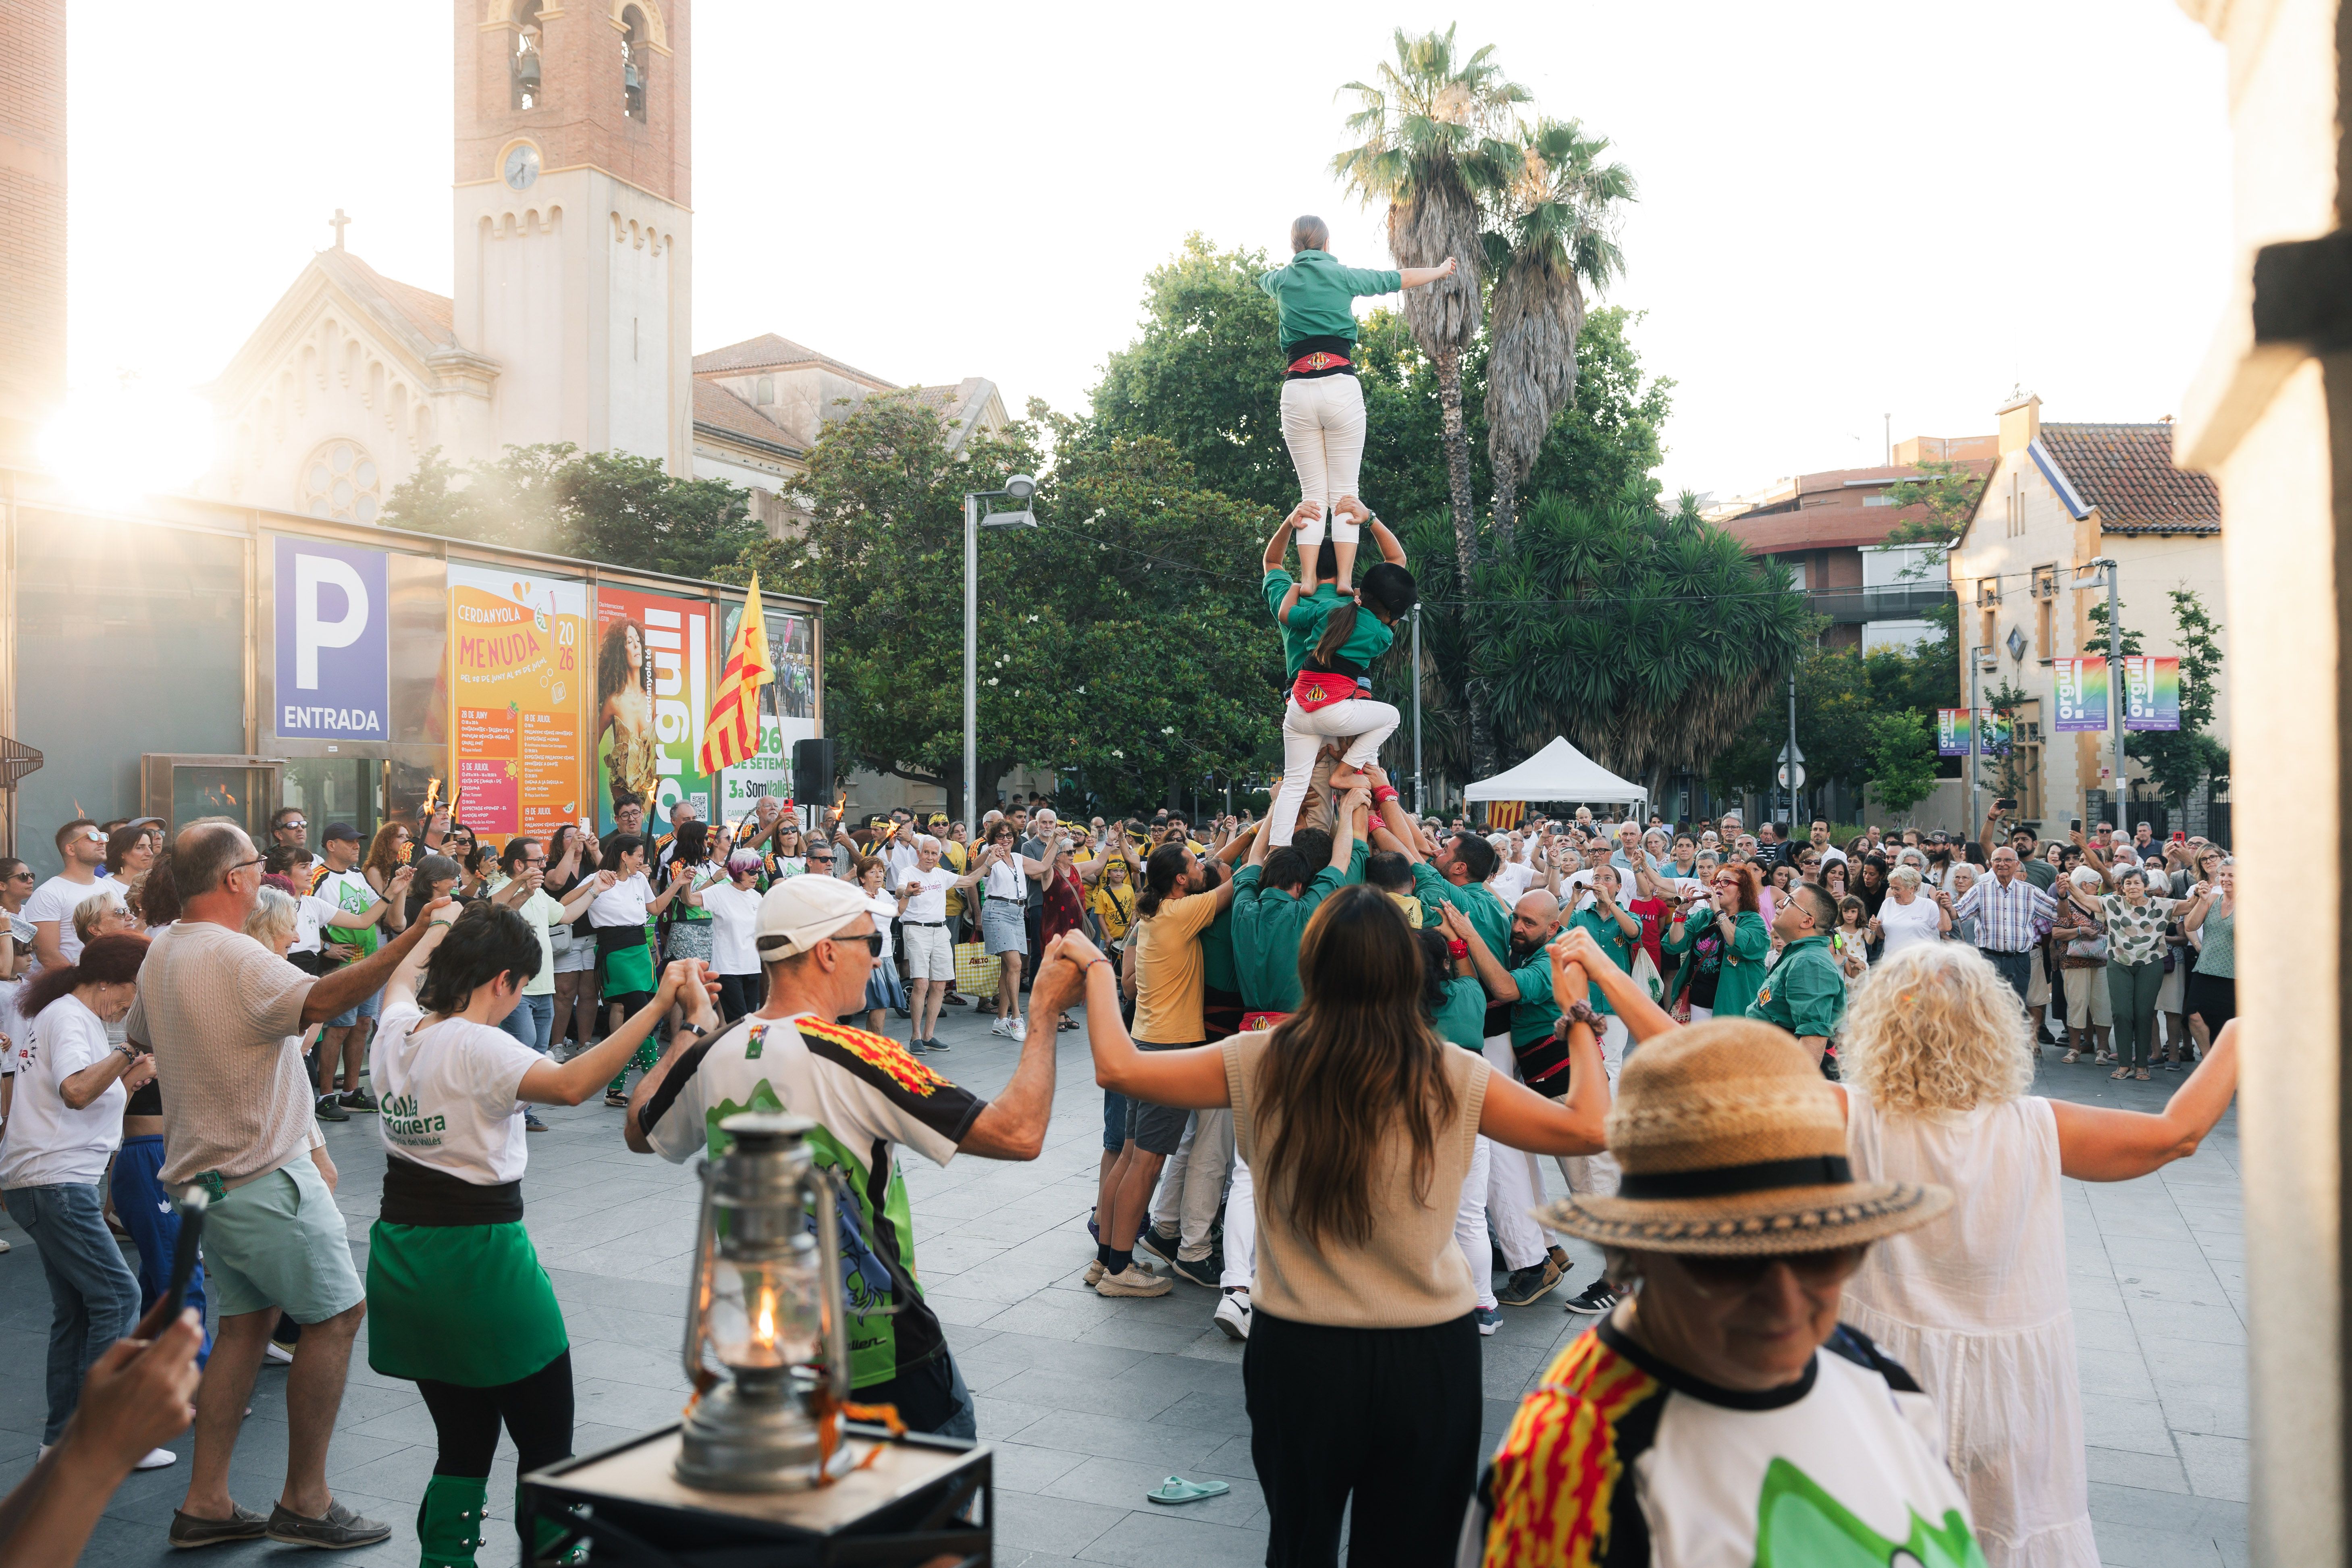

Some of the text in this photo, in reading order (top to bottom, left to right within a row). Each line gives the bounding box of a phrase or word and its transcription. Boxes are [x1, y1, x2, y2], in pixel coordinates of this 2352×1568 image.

[458, 605, 521, 623] CERDANYOLA
[604, 602, 624, 610] Internacional
[296, 553, 369, 690] P
[559, 621, 574, 646] 20
[460, 629, 540, 668] MENUDA
[559, 646, 574, 671] 26
[645, 648, 652, 660] té
[460, 674, 471, 683] DEL
[491, 673, 505, 683] JUNY
[506, 671, 514, 679] AL
[532, 656, 547, 672] JULIOL
[2055, 660, 2076, 719] orgull
[2126, 658, 2147, 717] orgull
[285, 706, 380, 731] ENTRADA
[468, 710, 474, 719] DE
[645, 608, 690, 823] orgull
[758, 726, 782, 754] 26
[1939, 710, 1950, 748] orgull
[733, 757, 794, 770] DE SETEMB
[729, 780, 744, 798] 3a
[476, 840, 489, 848] ULIOL
[381, 1091, 418, 1118] Colla
[407, 1138, 419, 1146] del
[418, 1136, 441, 1146] Vallès
